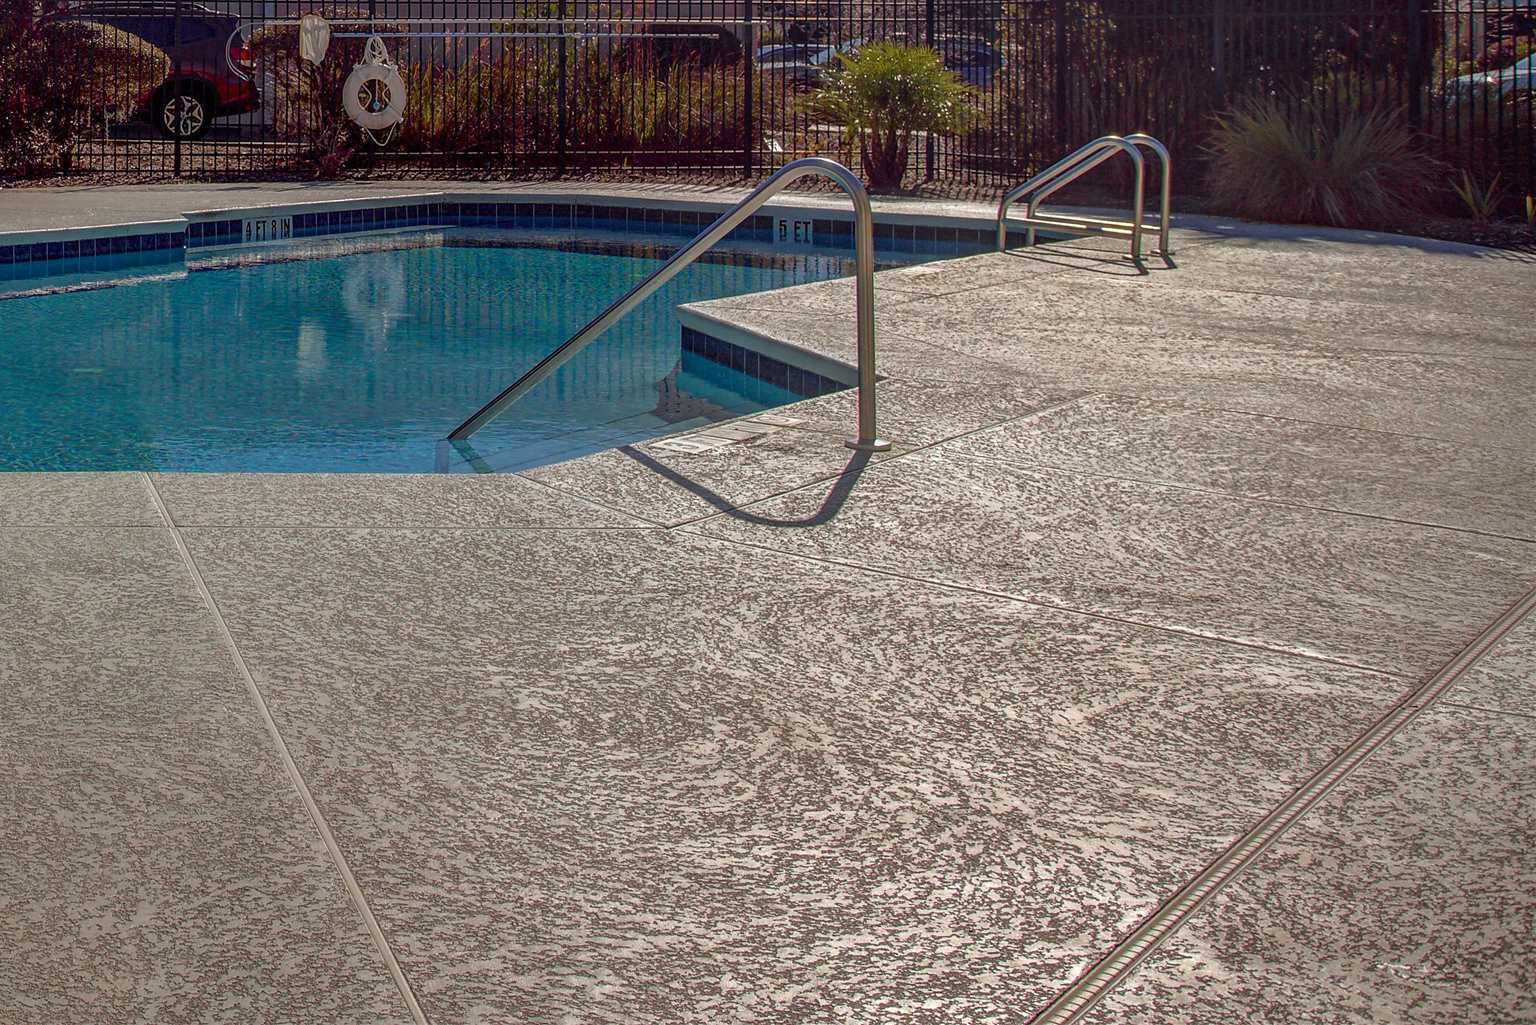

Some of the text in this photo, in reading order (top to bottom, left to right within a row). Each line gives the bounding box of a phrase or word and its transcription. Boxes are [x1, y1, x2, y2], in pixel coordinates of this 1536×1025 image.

[245, 221, 252, 237] 4
[255, 220, 267, 238] FT
[280, 218, 290, 237] IN
[779, 219, 811, 239] 5 FT
